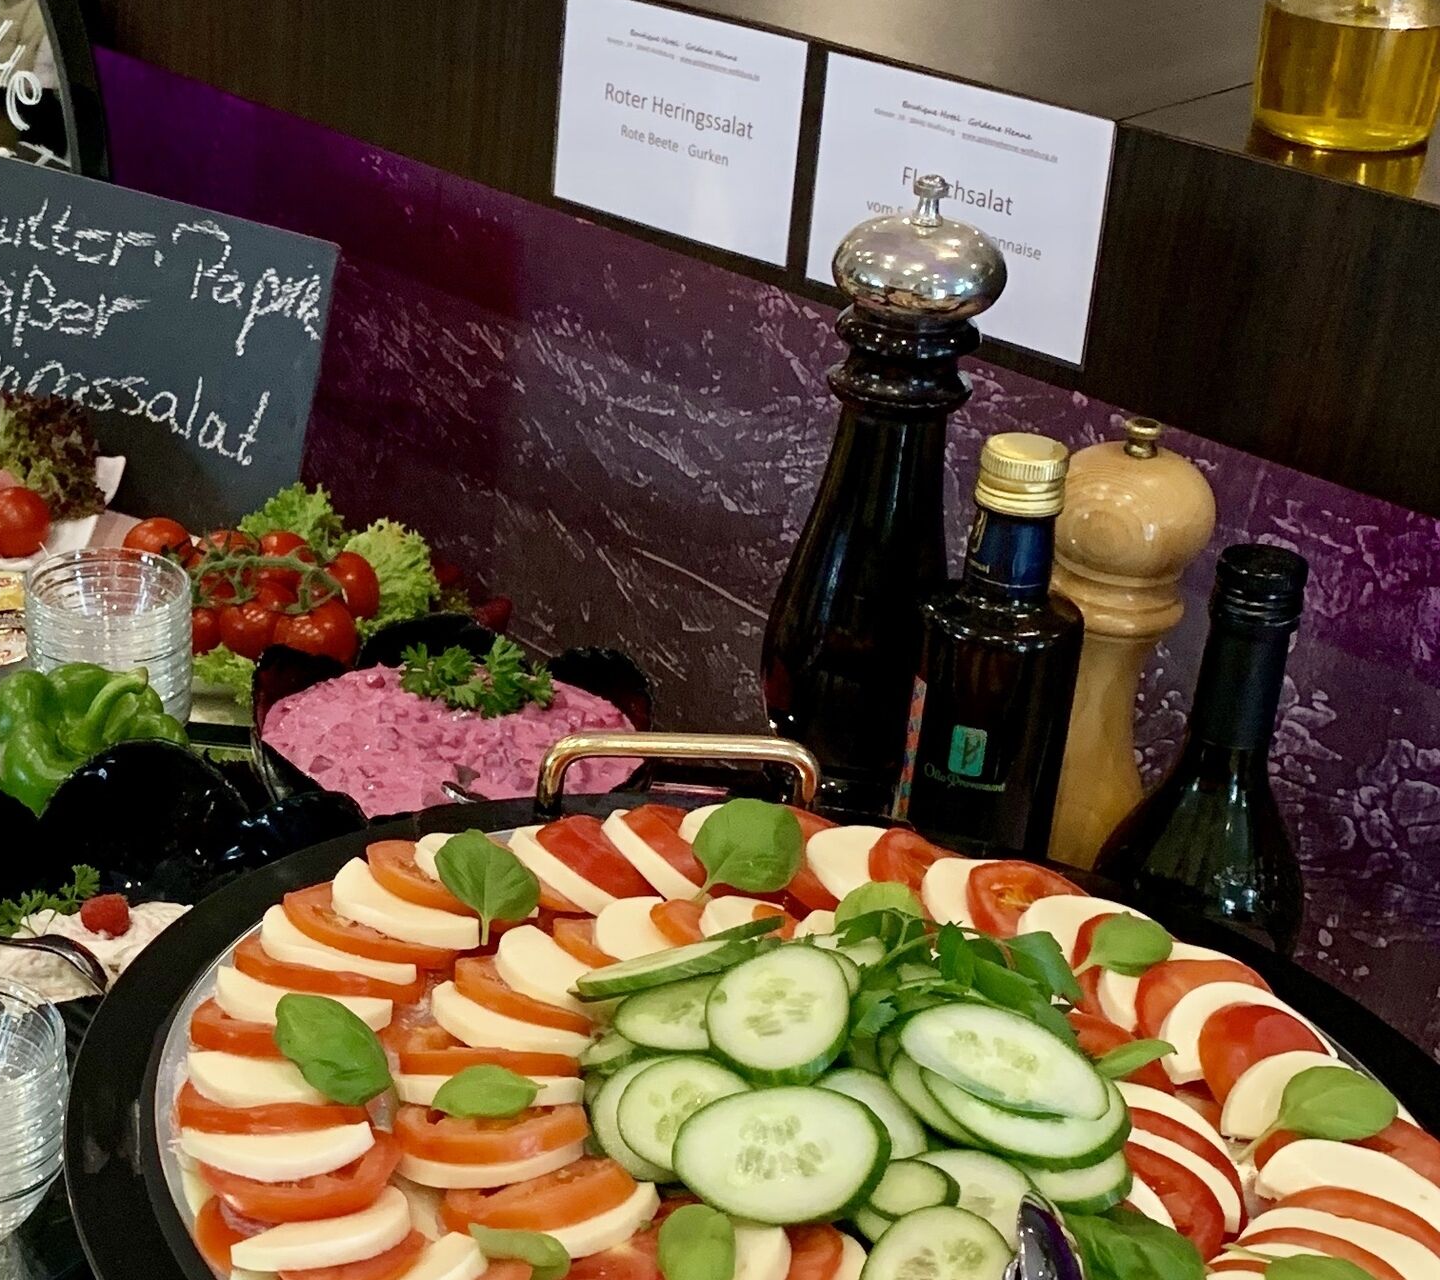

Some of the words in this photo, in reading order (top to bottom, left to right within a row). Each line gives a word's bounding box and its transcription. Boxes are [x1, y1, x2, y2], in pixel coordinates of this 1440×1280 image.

[604, 82, 649, 110] Roter
[652, 95, 754, 140] Heringssalat
[620, 124, 646, 143] Rote
[647, 132, 679, 153] Beete
[687, 144, 730, 167] Gurken
[866, 200, 894, 215] vom
[902, 166, 1015, 216] Flhsalat
